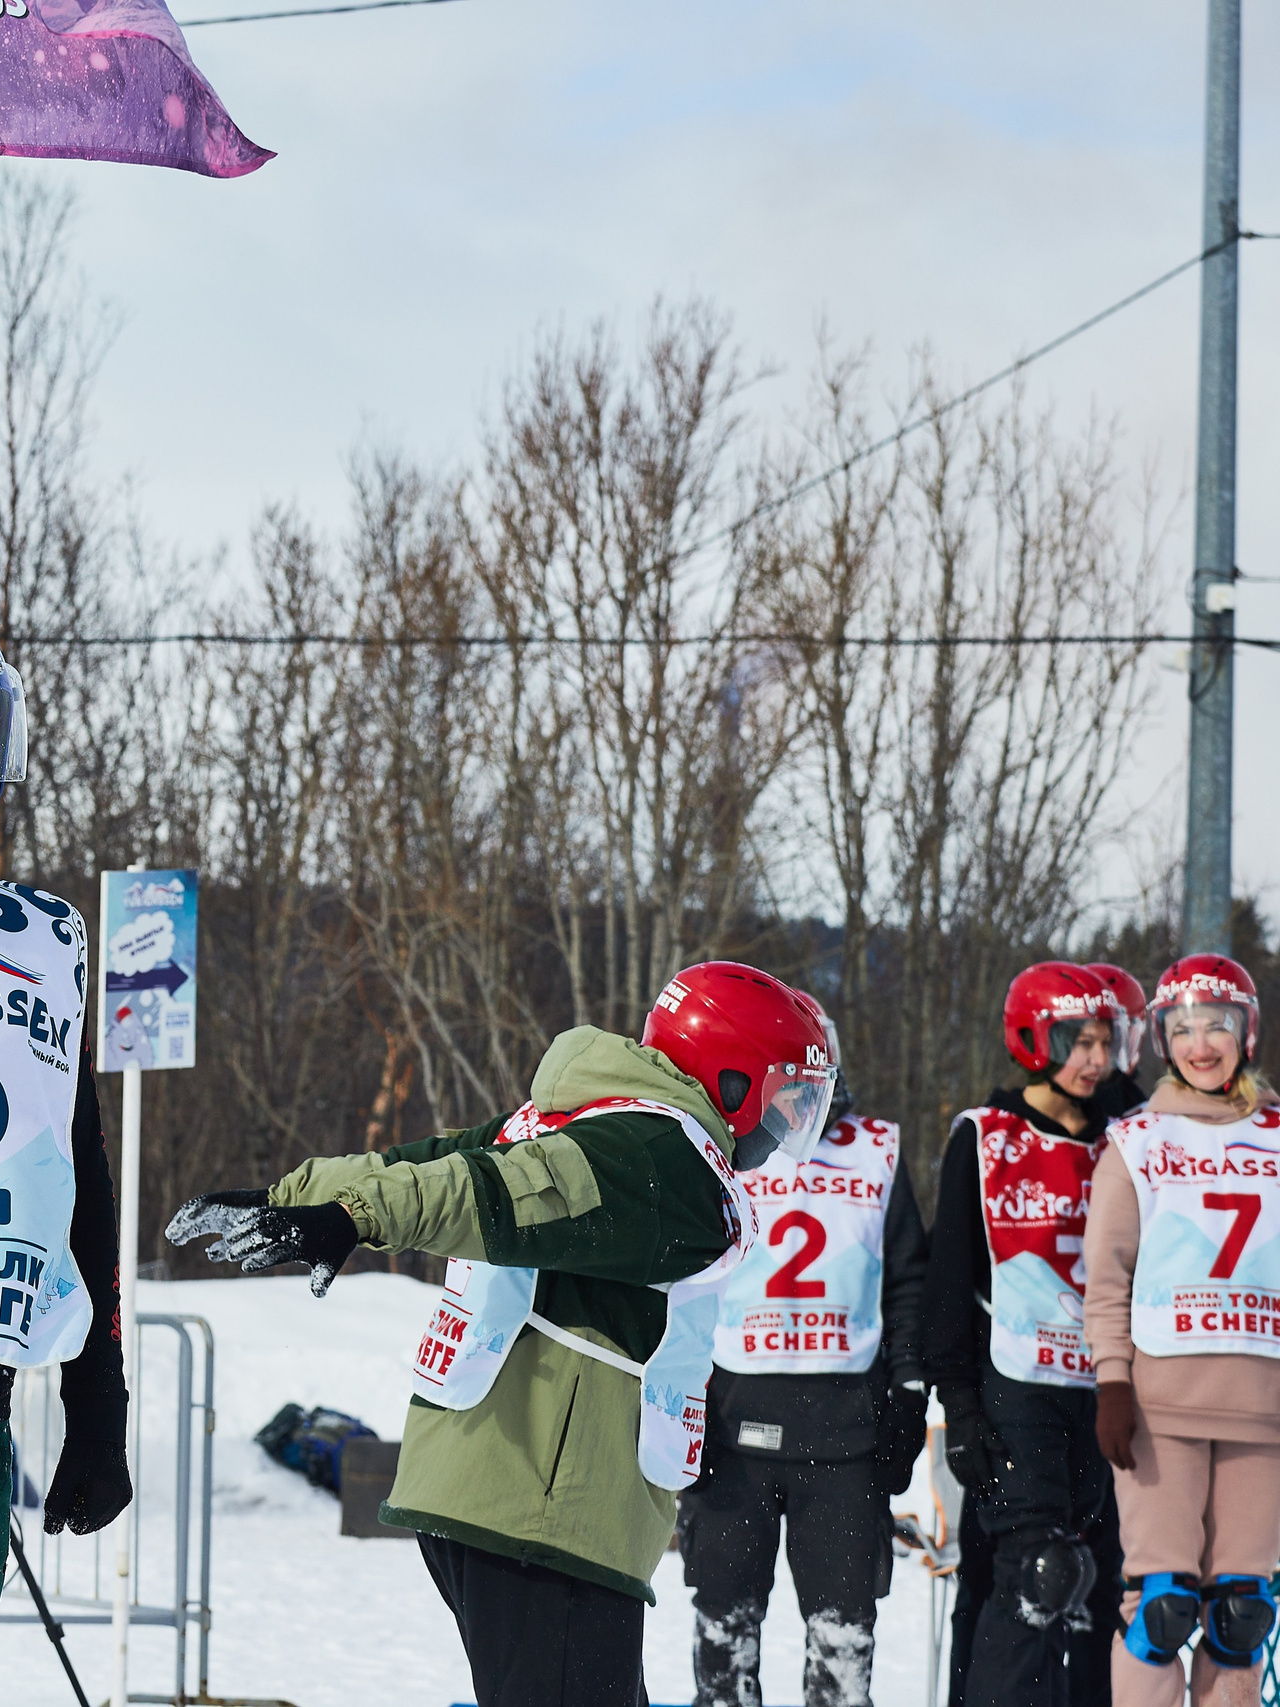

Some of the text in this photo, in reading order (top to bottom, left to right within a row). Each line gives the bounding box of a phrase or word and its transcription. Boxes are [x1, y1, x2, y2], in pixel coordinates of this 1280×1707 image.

[1202, 1191, 1262, 1279] 7
[765, 1210, 826, 1298] 2
[789, 1312, 848, 1329] ТОЛК
[1175, 1312, 1194, 1333] В
[743, 1331, 851, 1353] В СНЕГЕ
[1037, 1347, 1055, 1366] В
